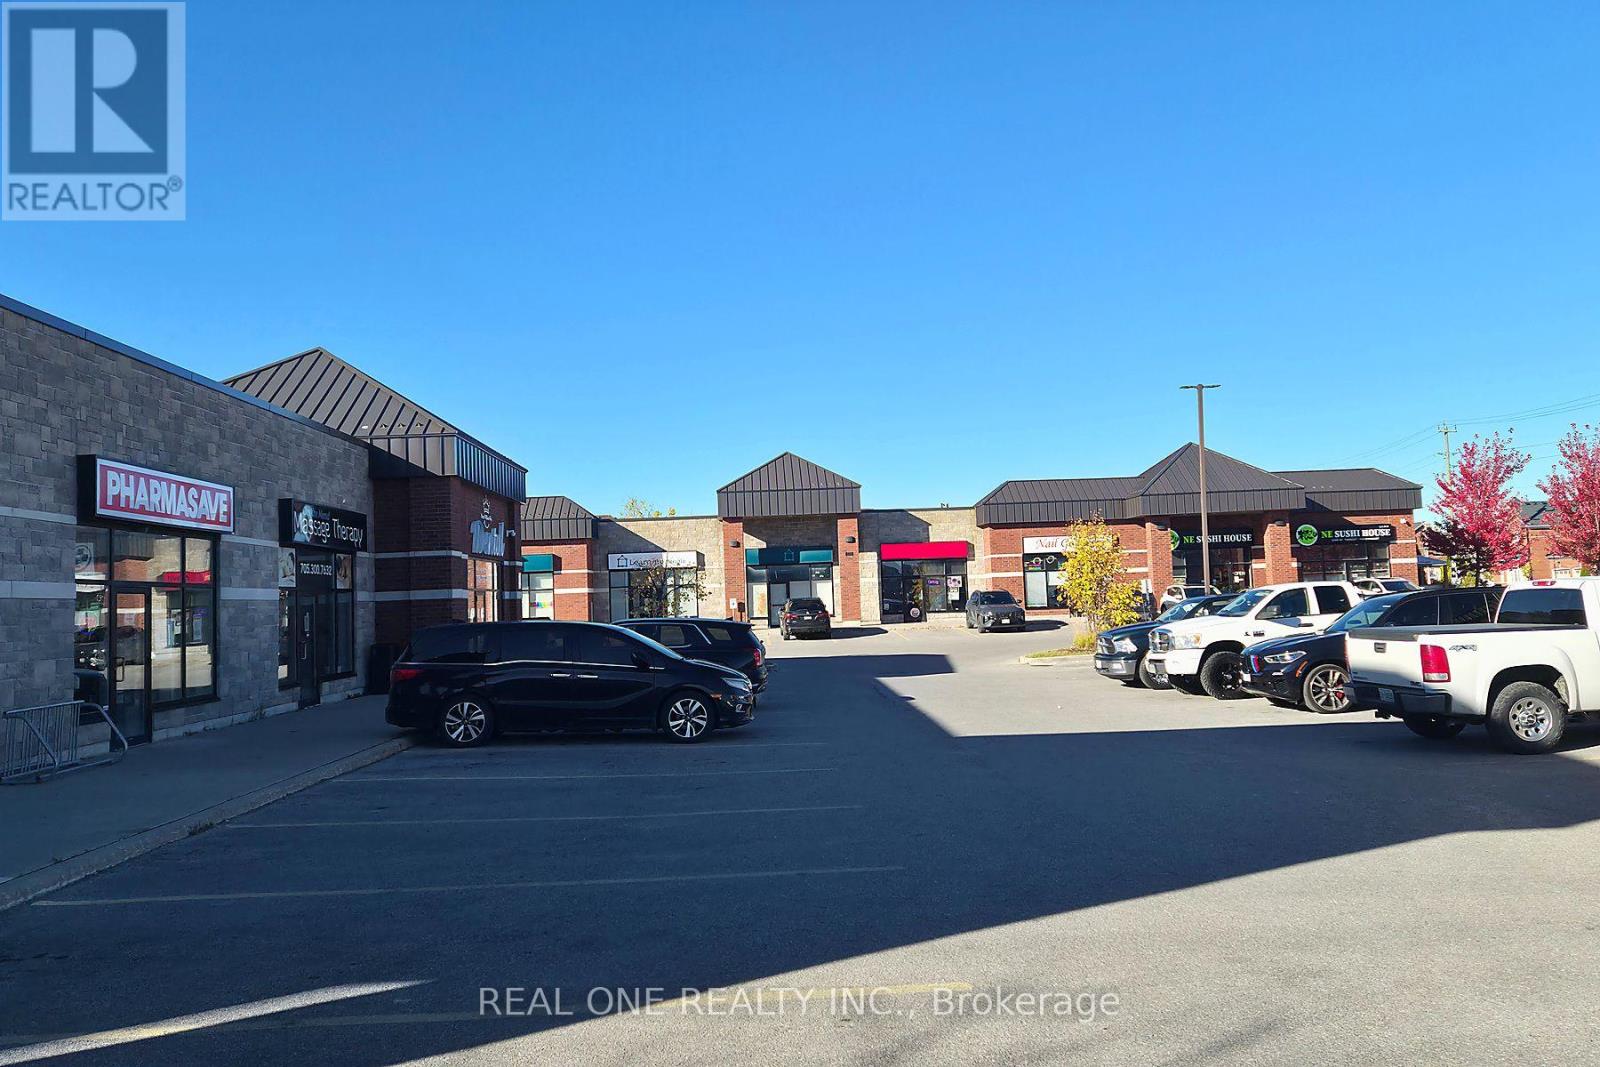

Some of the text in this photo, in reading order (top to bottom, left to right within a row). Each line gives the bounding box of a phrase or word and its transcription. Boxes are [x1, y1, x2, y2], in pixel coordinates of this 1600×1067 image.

[107, 471, 228, 523] PHARMASAVE
[293, 510, 331, 544] Massage
[332, 518, 364, 548] Therapy
[1183, 533, 1253, 544] NE SSHI HOUSE
[1320, 528, 1391, 539] NE SUSHI HOUSE
